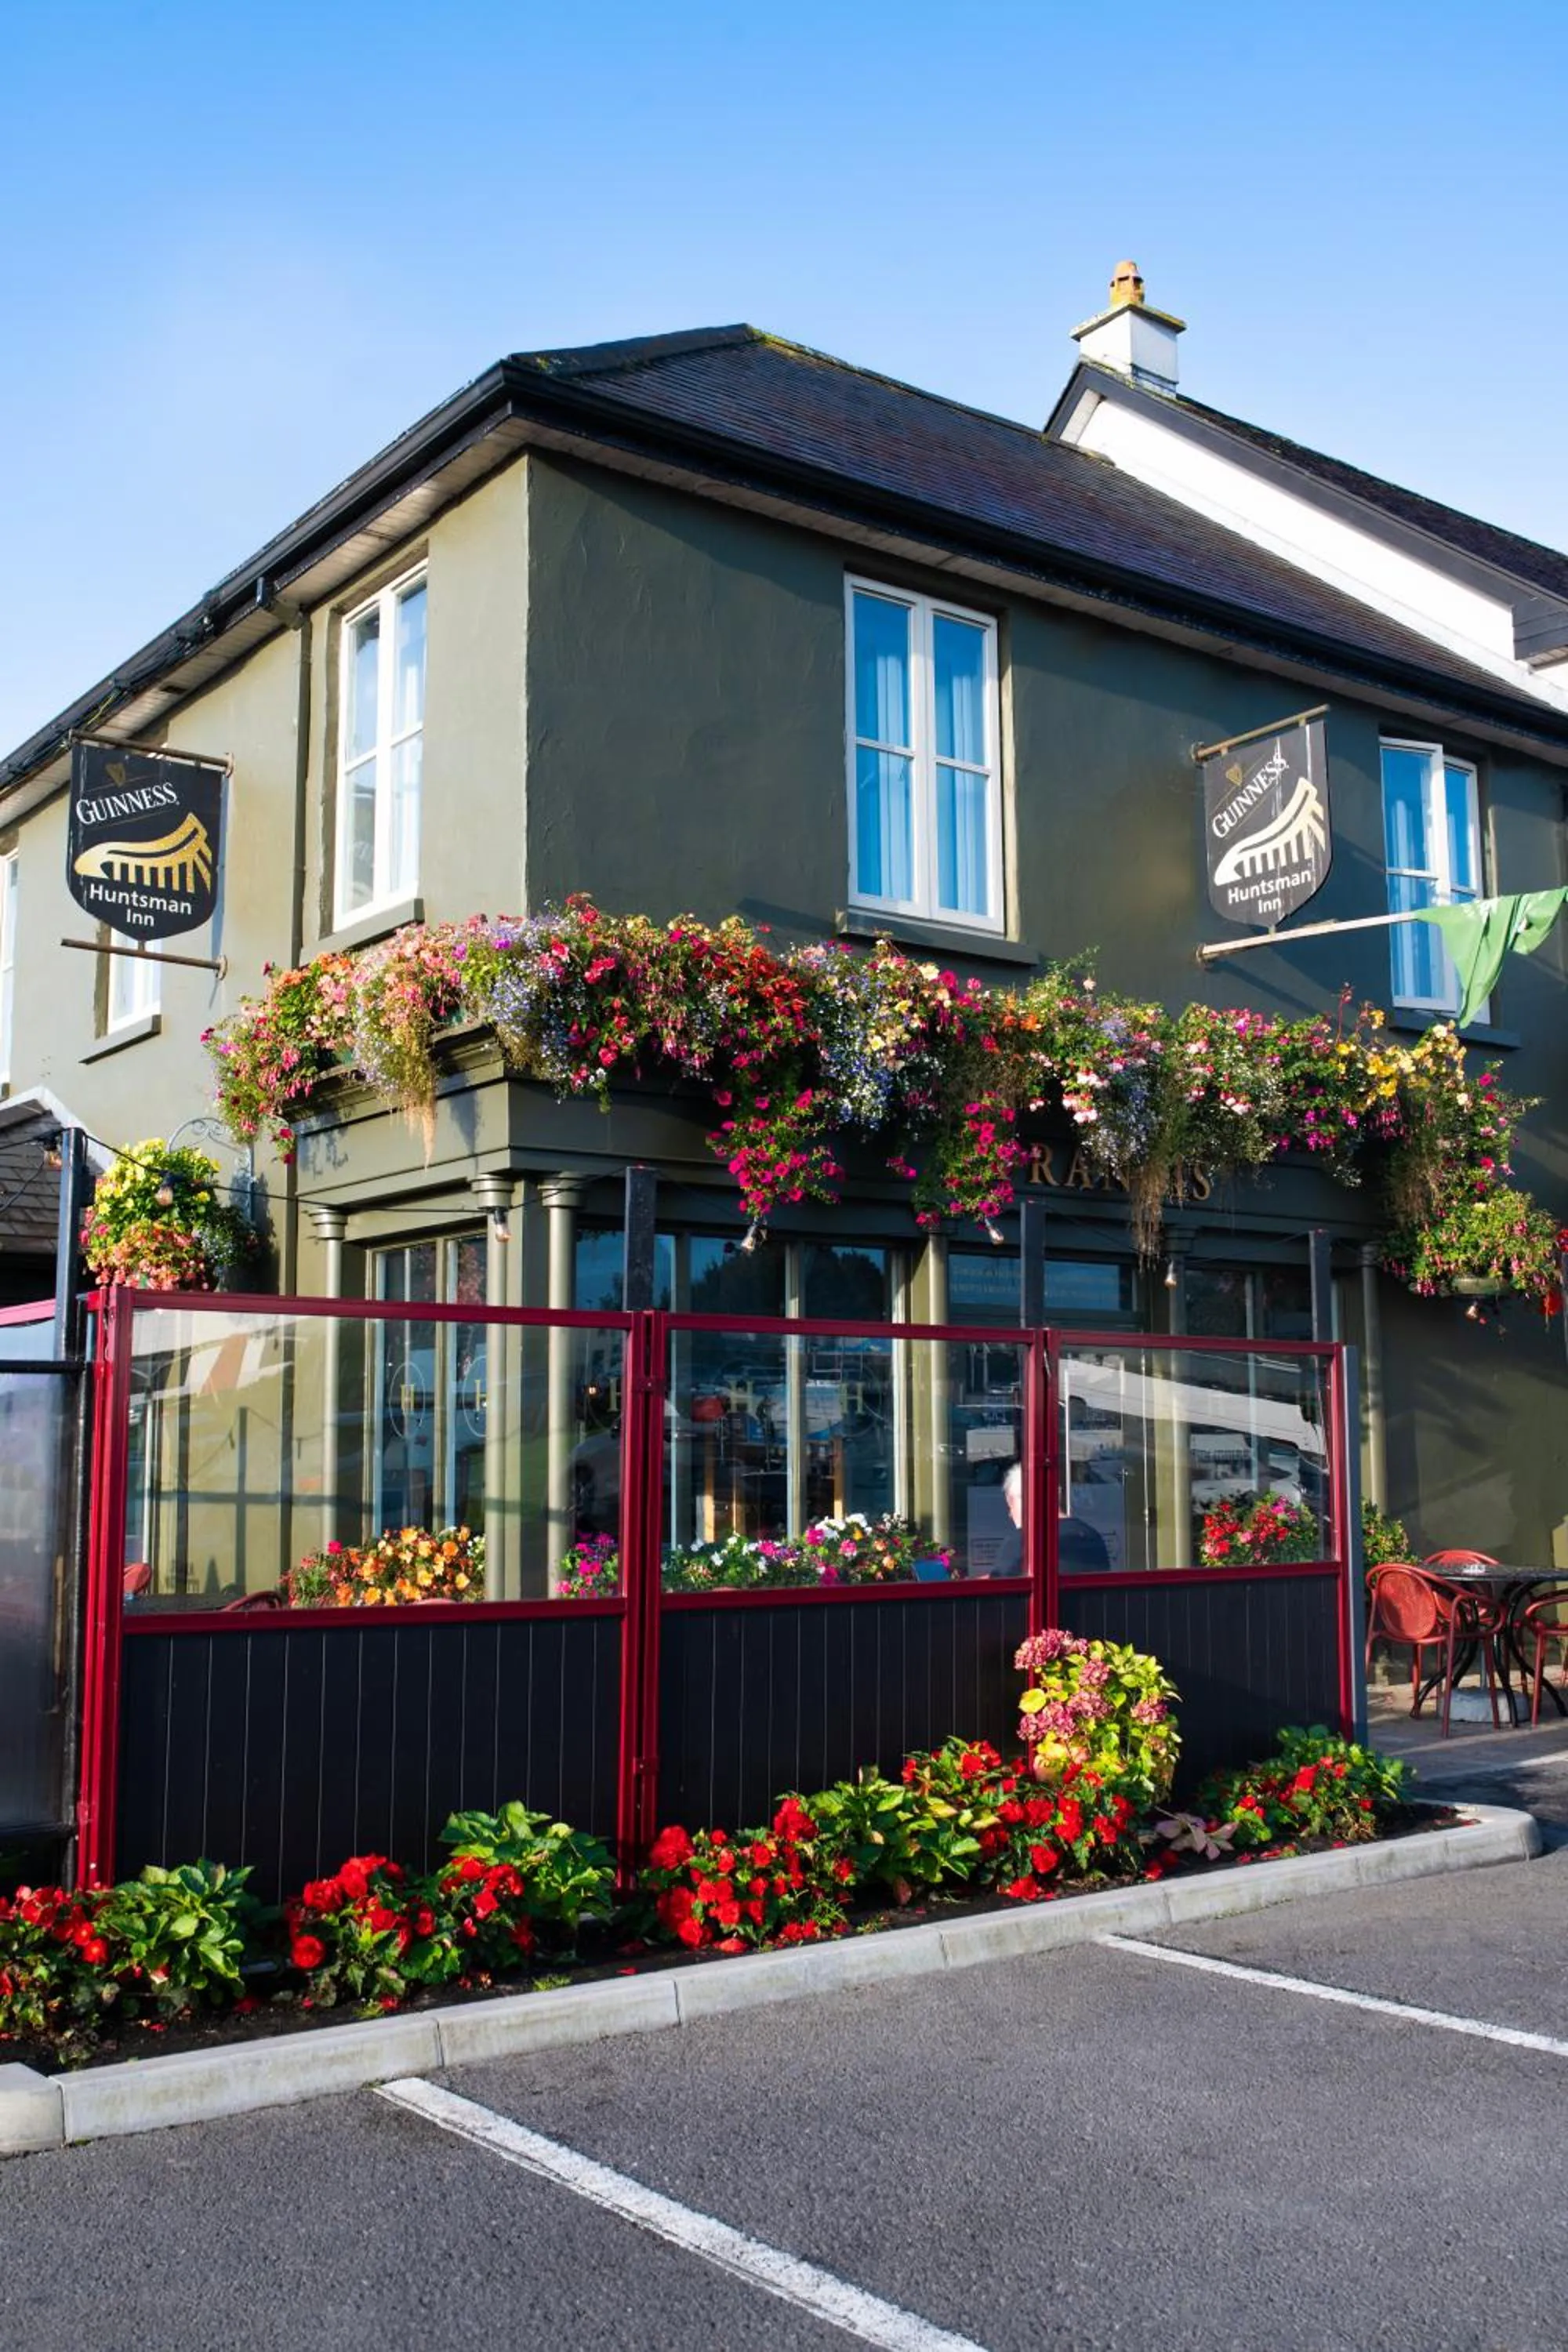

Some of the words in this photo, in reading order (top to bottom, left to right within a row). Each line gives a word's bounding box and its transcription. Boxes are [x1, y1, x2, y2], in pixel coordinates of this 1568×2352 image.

[76, 782, 177, 824] GUINNESS
[1212, 753, 1287, 837] GUINNESS
[89, 884, 192, 915] Huntsman
[1228, 869, 1312, 904] Huntsman
[126, 909, 154, 926] Inn
[1258, 898, 1281, 913] Inn
